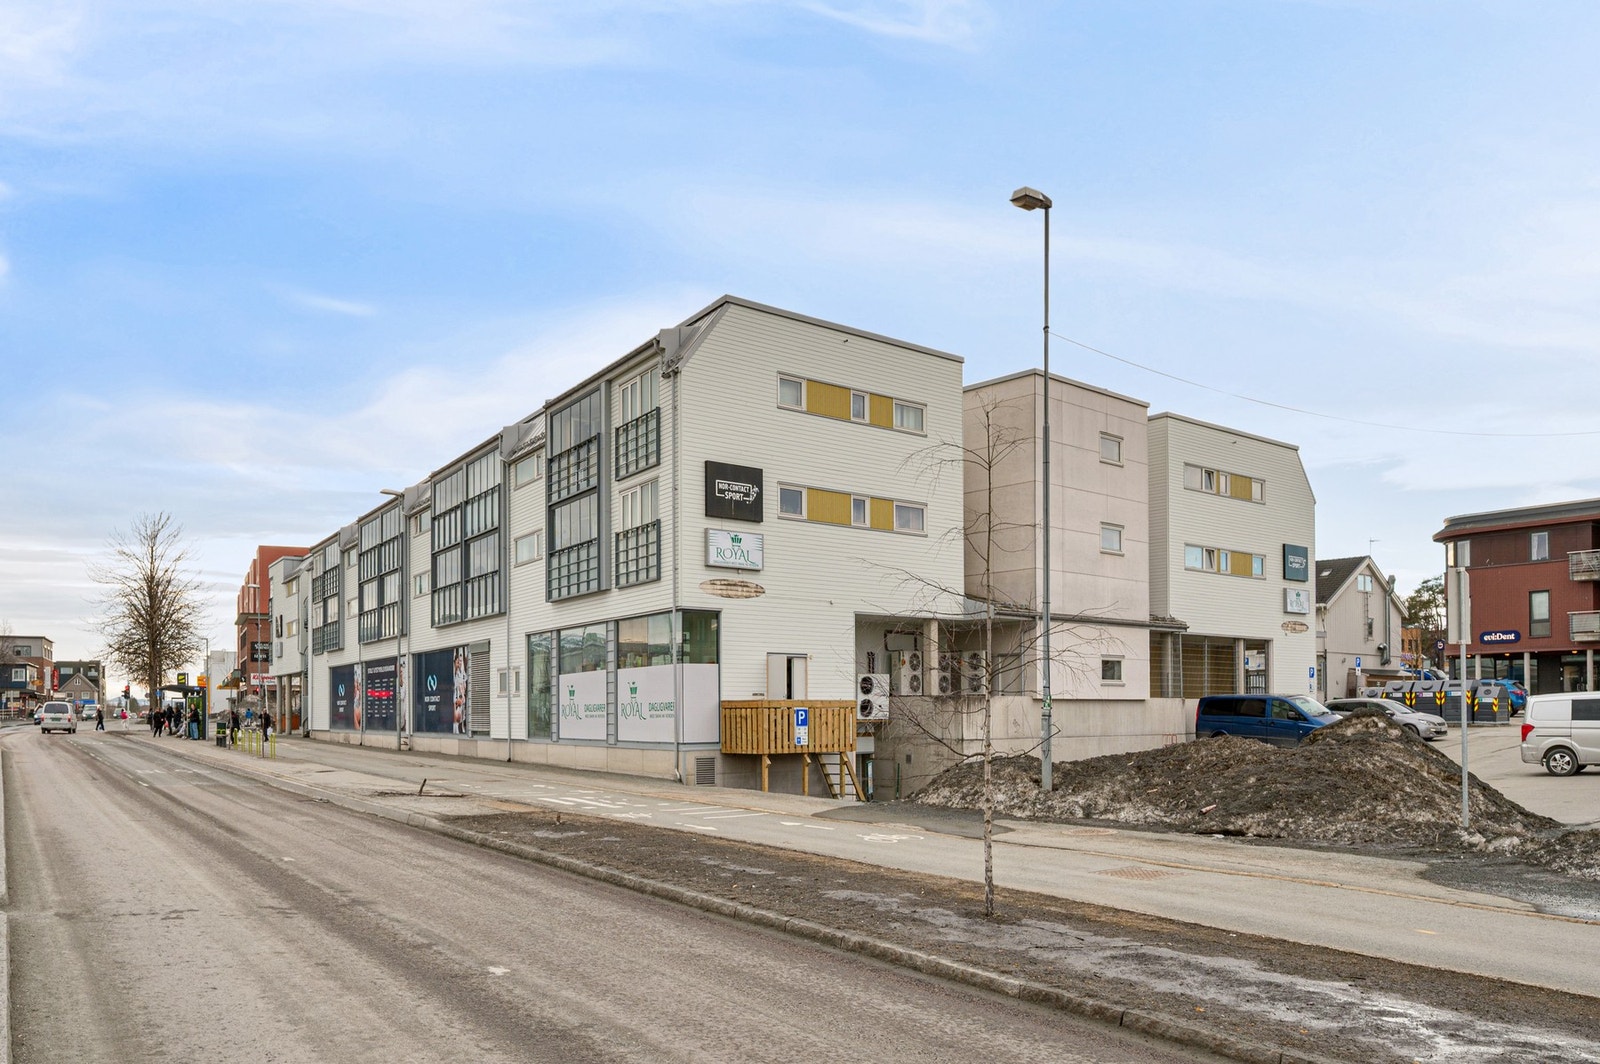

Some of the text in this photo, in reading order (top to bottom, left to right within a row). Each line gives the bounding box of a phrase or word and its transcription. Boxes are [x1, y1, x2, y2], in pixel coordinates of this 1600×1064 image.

[718, 482, 750, 493] NOR-CONTACT
[724, 491, 744, 501] SPORT
[716, 546, 758, 565] ROYAL
[561, 701, 582, 720] ROYAL
[620, 701, 647, 720] ROYAL
[798, 710, 806, 725] P
